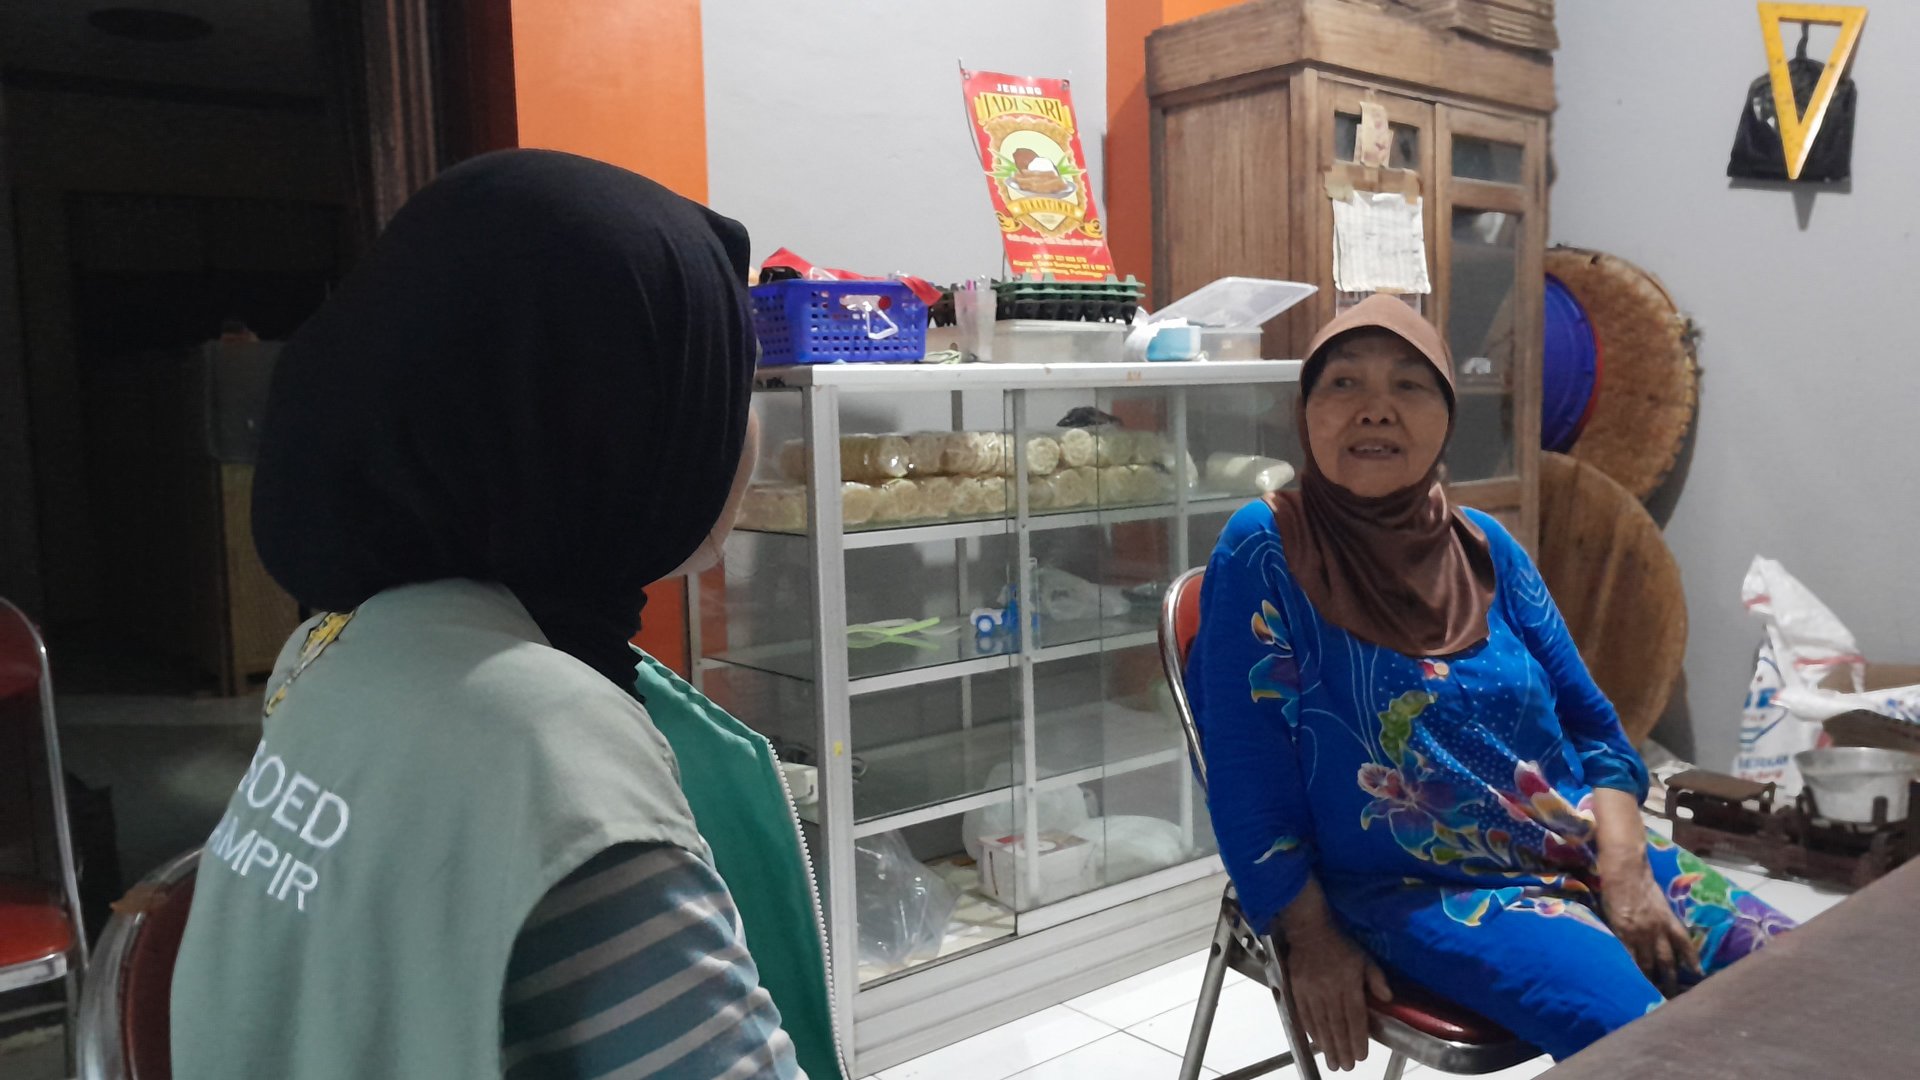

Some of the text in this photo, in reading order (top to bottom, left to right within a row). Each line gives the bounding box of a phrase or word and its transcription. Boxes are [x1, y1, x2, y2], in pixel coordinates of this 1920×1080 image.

[996, 83, 1042, 96] JENANG
[983, 94, 1062, 122] JADI SARI
